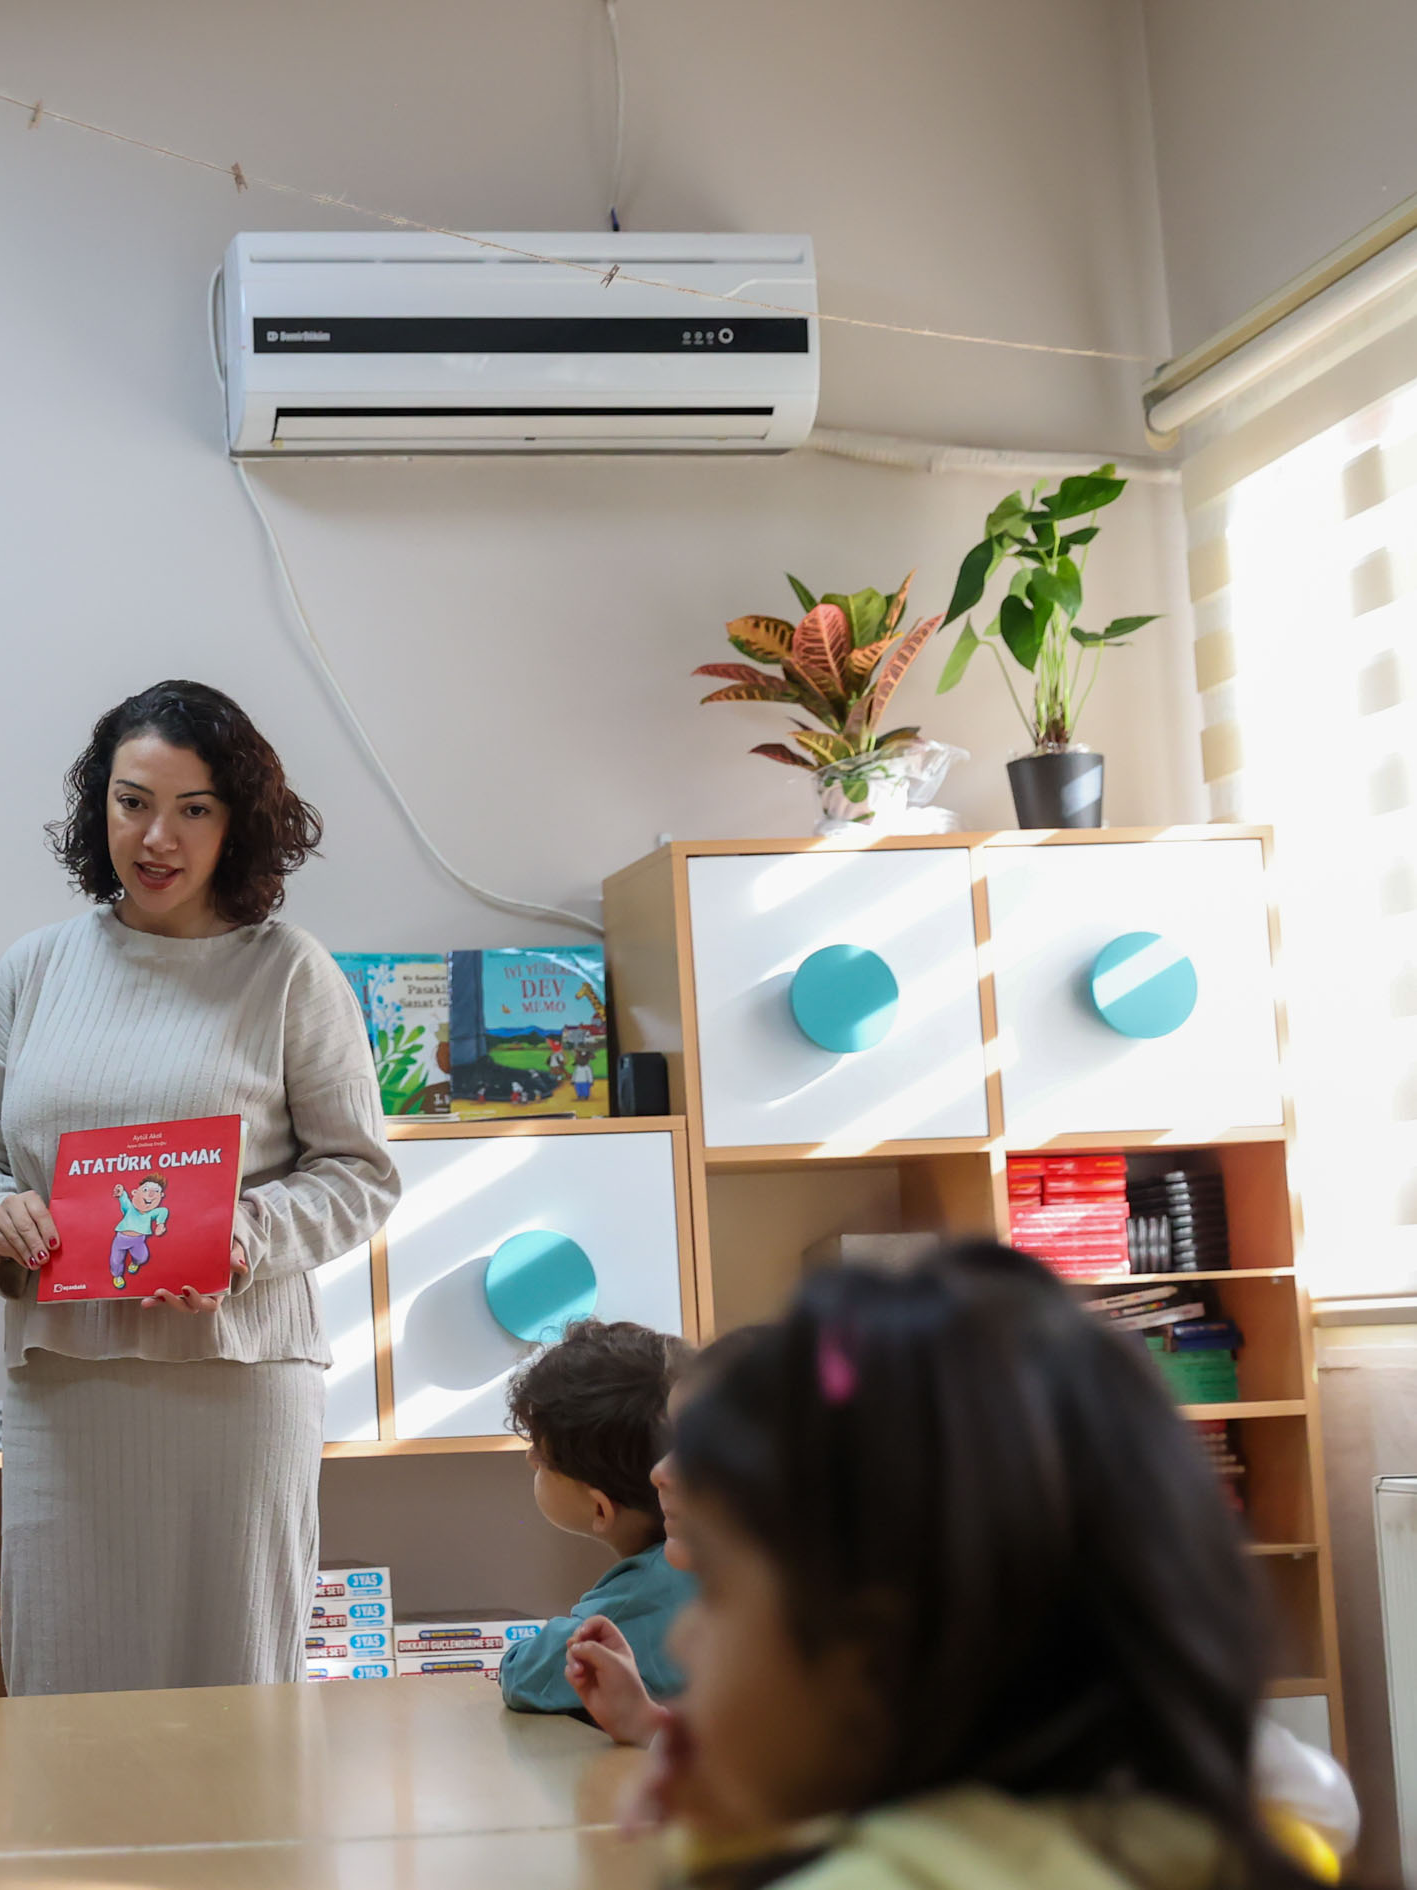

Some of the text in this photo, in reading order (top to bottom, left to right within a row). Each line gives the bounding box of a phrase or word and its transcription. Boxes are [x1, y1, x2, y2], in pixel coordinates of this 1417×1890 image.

[520, 978, 566, 999] DEV
[521, 1000, 567, 1014] MEMO
[68, 1148, 222, 1176] ATATÜRK OLMAK
